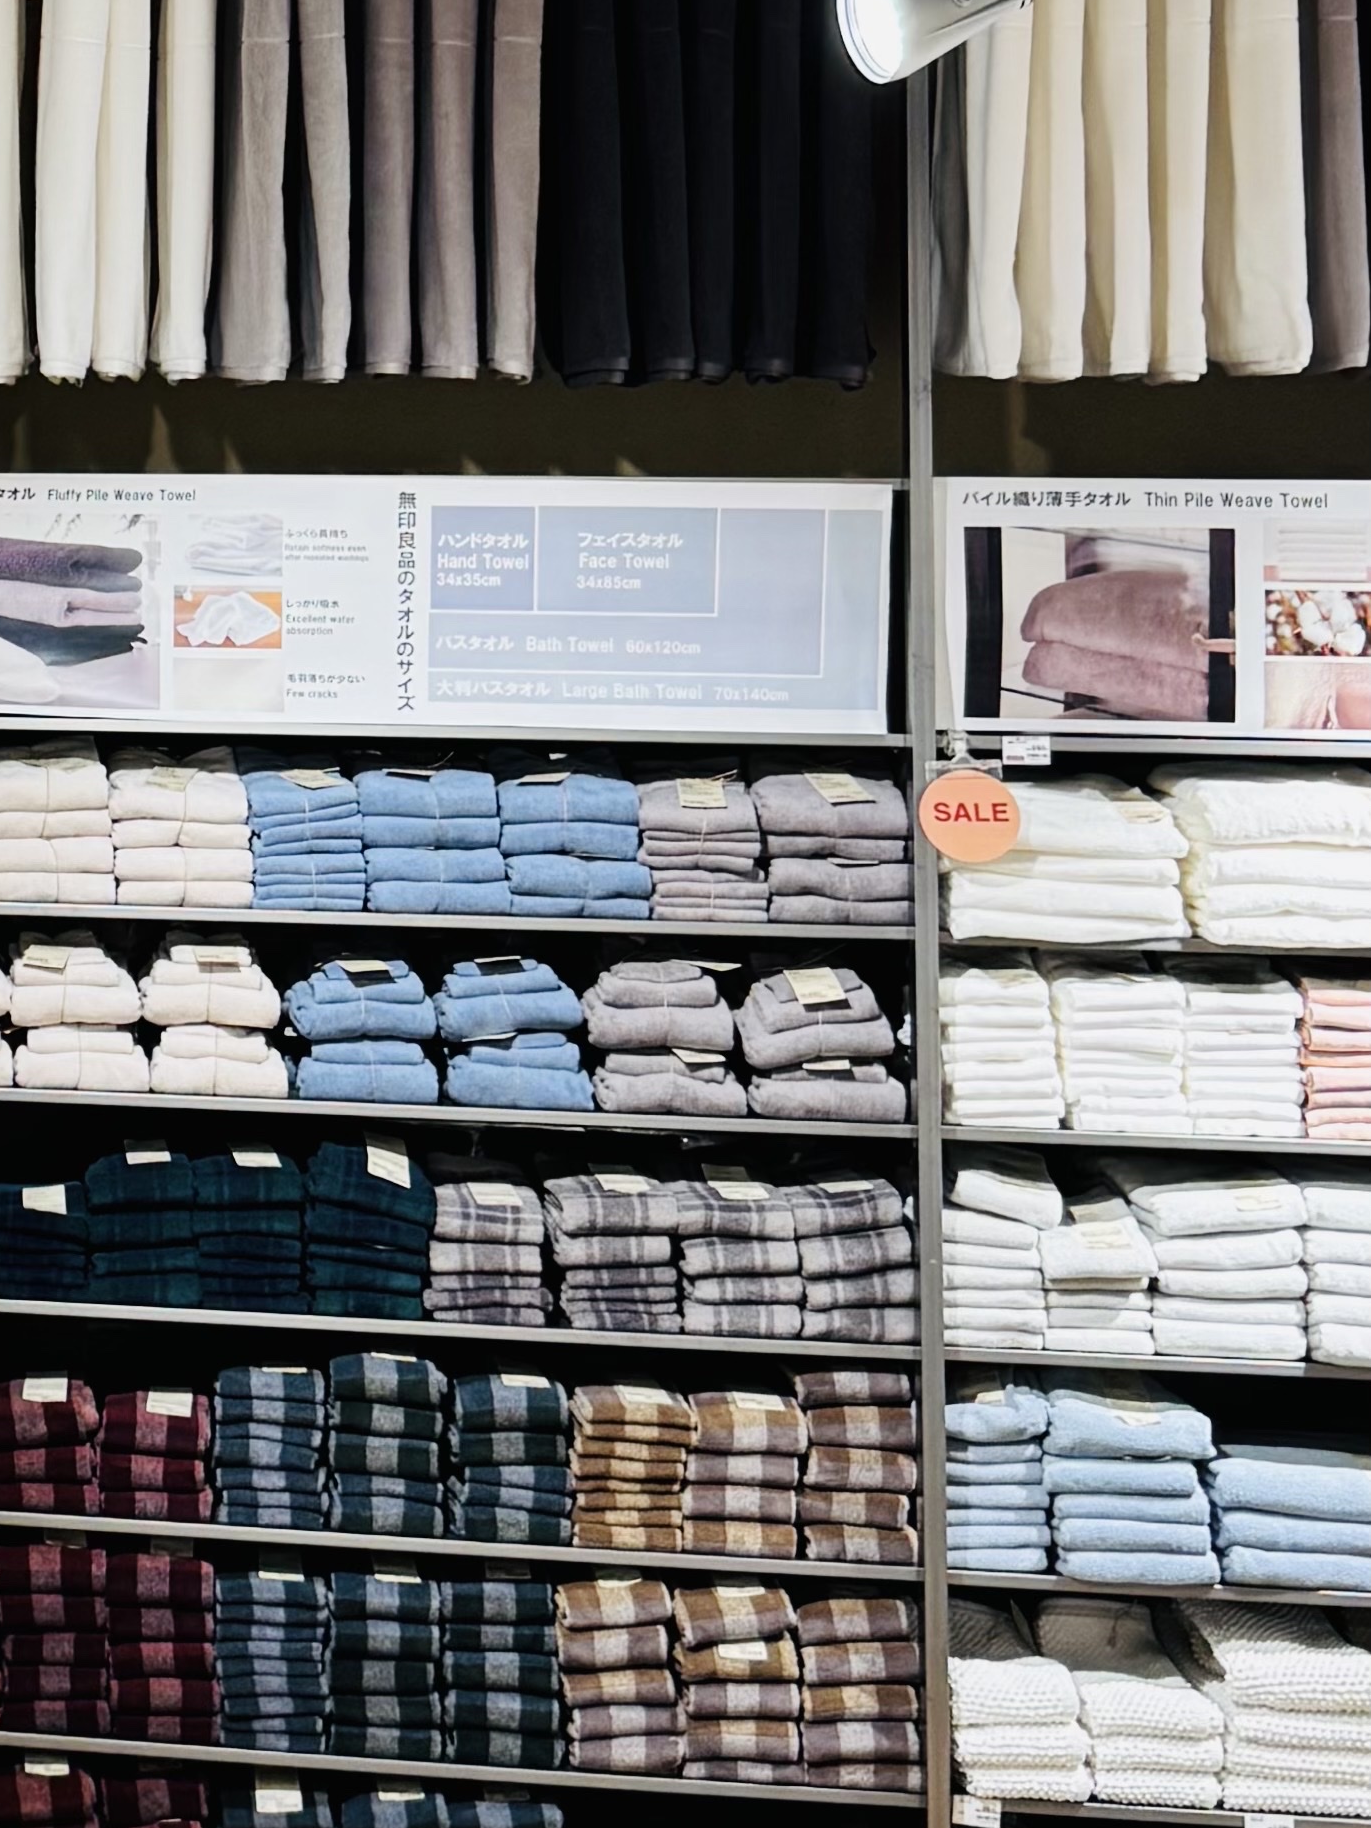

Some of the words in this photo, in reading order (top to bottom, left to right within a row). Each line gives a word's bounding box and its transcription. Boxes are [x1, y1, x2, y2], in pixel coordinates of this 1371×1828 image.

[47, 488, 82, 502] Fluffy
[86, 489, 109, 501] Pile
[114, 489, 155, 502] Weave
[159, 489, 196, 502] Towel
[1144, 492, 1178, 508] Thin
[1185, 492, 1214, 508] Pile
[1220, 492, 1274, 508] Weave
[1279, 492, 1328, 508] Towel
[437, 532, 529, 549] ハンドタオル
[577, 532, 683, 549] フェイスタオル
[437, 553, 477, 569] Hand
[483, 553, 529, 570] Towel
[578, 553, 617, 569] Face
[624, 554, 669, 570] Towel
[397, 491, 417, 712] 無印良品のタオルのサイズ
[286, 614, 327, 624] Excellent
[286, 626, 333, 636] absorption
[525, 636, 562, 653] Bath
[567, 636, 614, 653] Towel
[286, 688, 304, 698] Few
[307, 688, 338, 699] cracks
[561, 681, 608, 699] Large
[613, 682, 650, 700] Bath
[657, 683, 703, 701] Towel
[933, 802, 1010, 822] SALE
